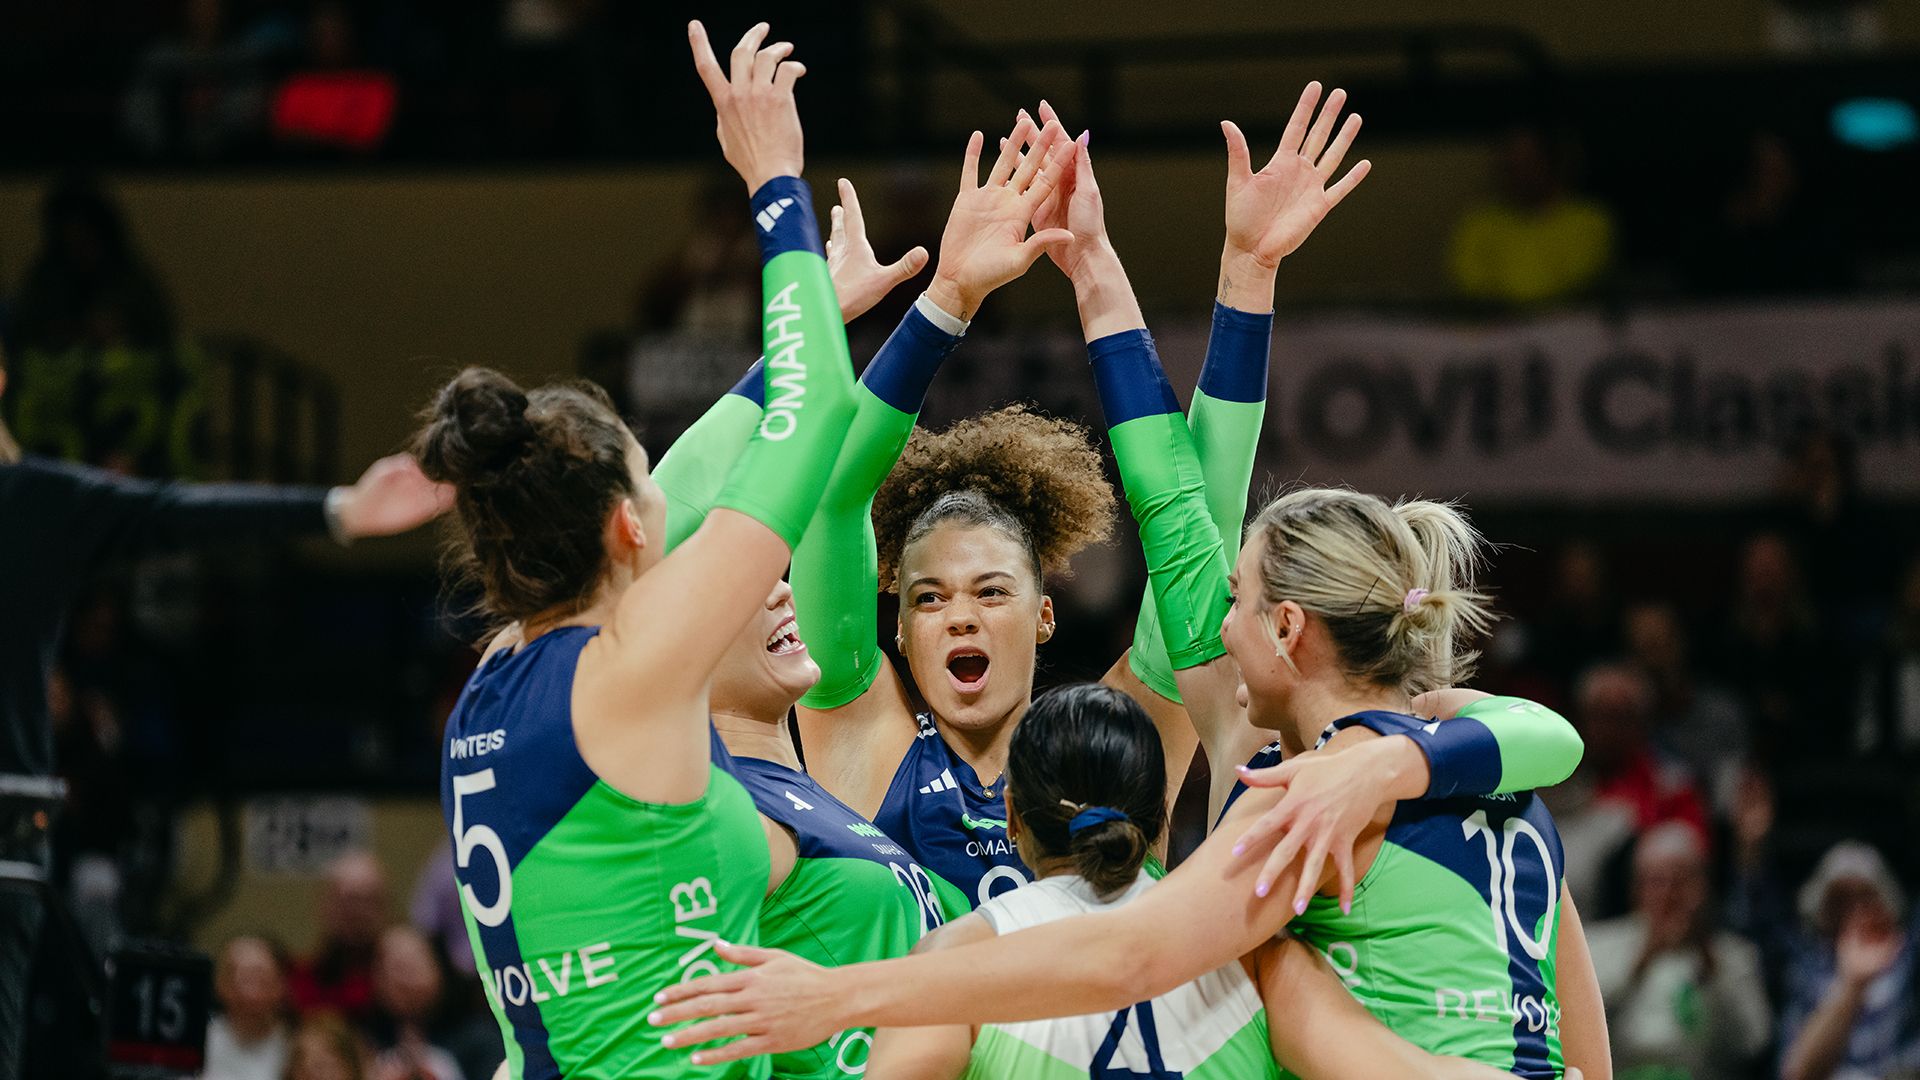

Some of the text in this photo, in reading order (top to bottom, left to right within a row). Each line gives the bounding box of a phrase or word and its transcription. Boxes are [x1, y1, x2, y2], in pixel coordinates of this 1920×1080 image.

[760, 281, 808, 441] OMAHA
[1581, 342, 1920, 460] Classi
[453, 768, 512, 927] 5
[1461, 809, 1557, 961] 10
